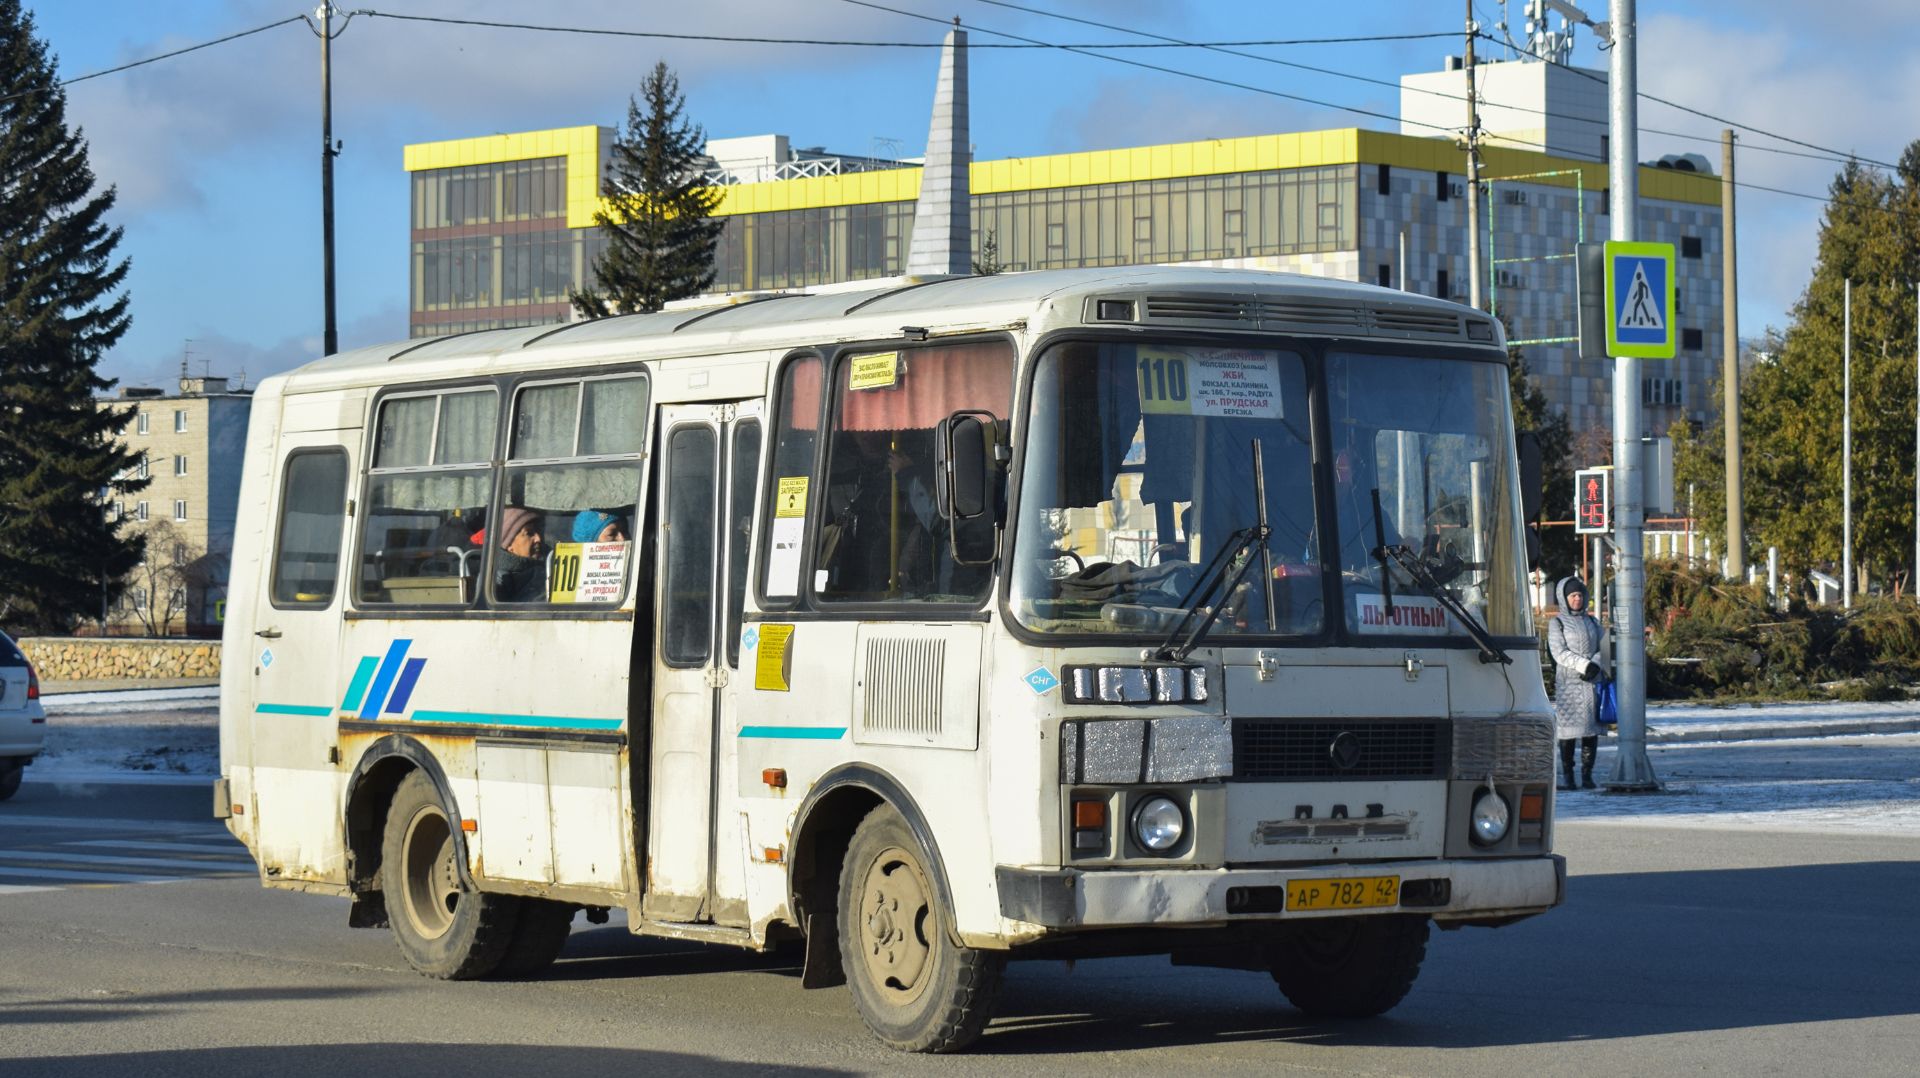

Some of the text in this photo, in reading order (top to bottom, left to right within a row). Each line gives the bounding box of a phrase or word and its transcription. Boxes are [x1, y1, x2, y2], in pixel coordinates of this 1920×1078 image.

[1139, 358, 1187, 401] 110
[1231, 381, 1269, 389] КАЛИНИНА
[1248, 390, 1274, 398] РАДУГА
[1219, 398, 1268, 408] ПРУДСКАЯ
[1223, 408, 1253, 416] БЕРЕЗКА
[1581, 504, 1604, 526] 45
[553, 555, 580, 592] 110
[592, 586, 618, 595] ПРУДСКАЯ
[1031, 675, 1051, 685] СНГ
[1297, 879, 1393, 906] АР 782 42
